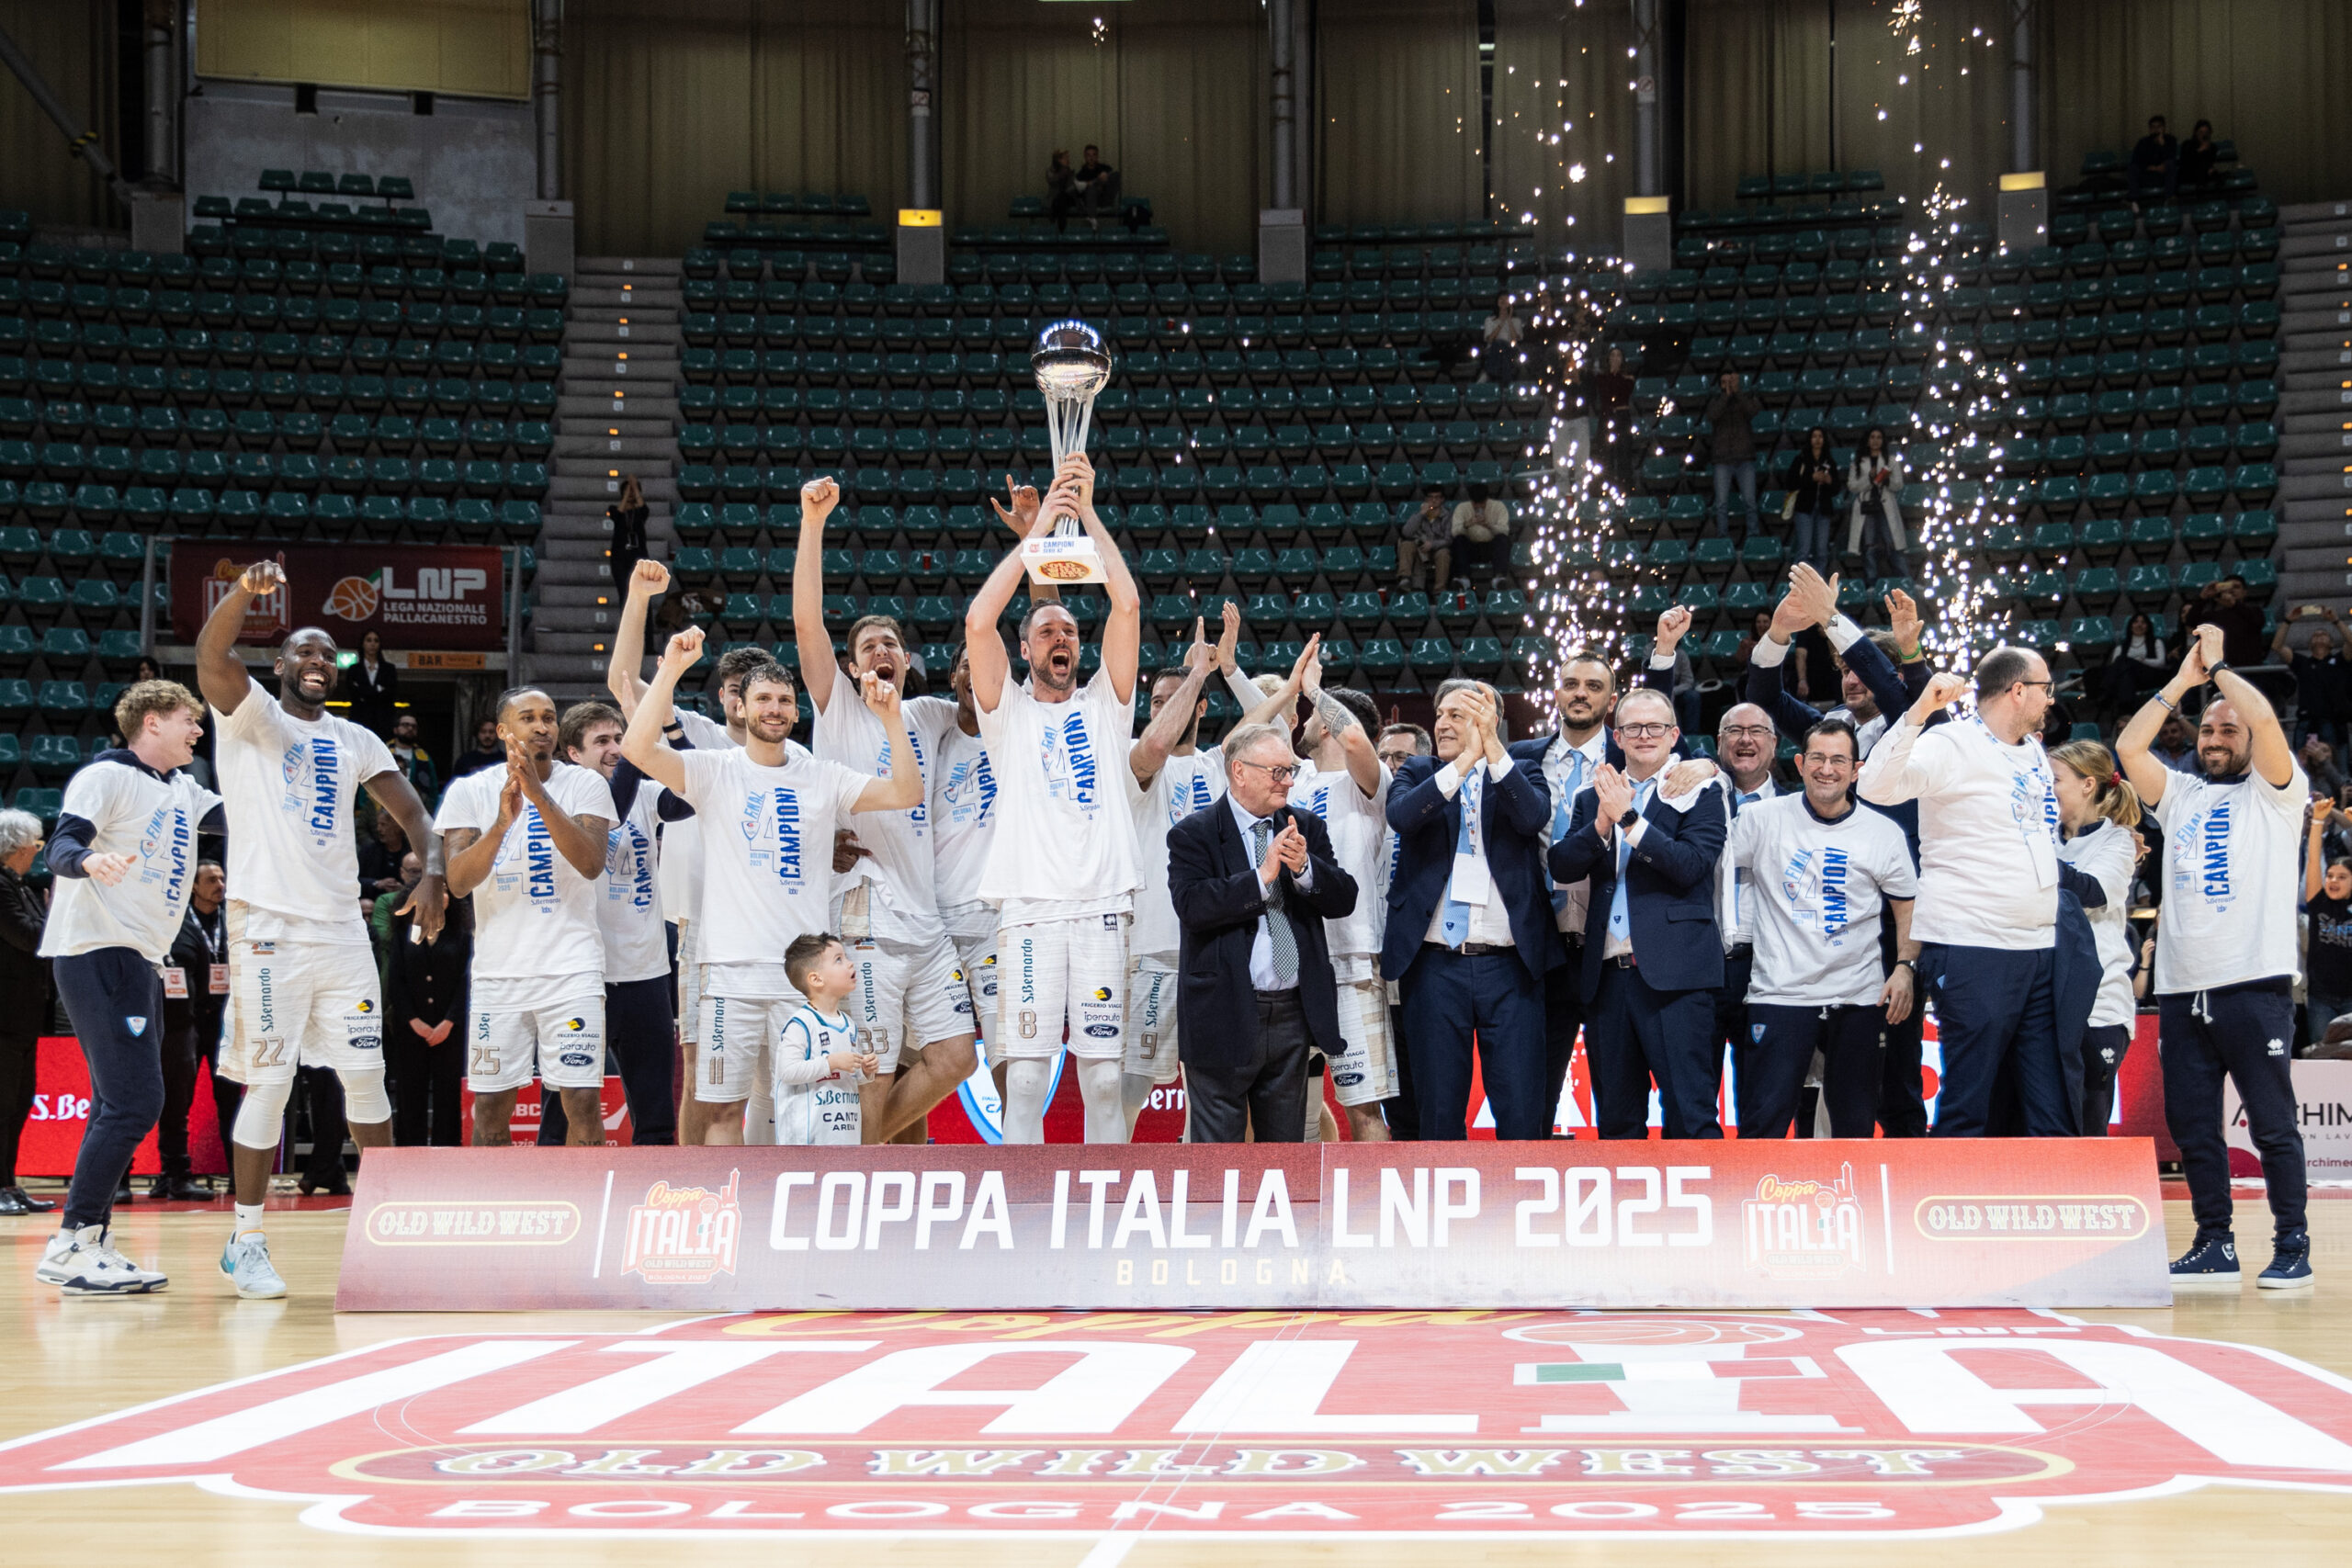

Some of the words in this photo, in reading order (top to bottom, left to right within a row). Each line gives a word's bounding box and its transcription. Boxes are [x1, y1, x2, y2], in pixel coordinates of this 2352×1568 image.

[1043, 540, 1075, 548] CAMPIONI
[382, 567, 487, 600] LNP
[383, 603, 415, 613] LEGA
[418, 604, 486, 615] NAZIONALE
[383, 614, 487, 625] PALLACANESTRO
[419, 656, 442, 665] BAR
[1063, 711, 1096, 804] CAMPIONI
[311, 738, 338, 830] CAMPIONI
[744, 791, 765, 820] FINAL
[145, 807, 168, 840] FINAL
[775, 787, 801, 879] CAMPIONI
[166, 807, 189, 901] CAMPIONI
[1784, 848, 1812, 881] FINAL
[2203, 801, 2231, 897] CAMPIONI
[1823, 847, 1849, 934] CAMPIONI
[1021, 938, 1035, 1004] S.Bernardo
[257, 967, 274, 1032] S.Bernardo
[861, 962, 878, 1022] S.Bernardo
[712, 997, 726, 1053] S.Bernard
[1018, 1008, 1037, 1039] 8
[1091, 1025, 1114, 1037] Ford
[251, 1036, 286, 1068] 22
[858, 1026, 889, 1055] 33
[1140, 1031, 1158, 1060] 9
[469, 1044, 501, 1075] 25
[563, 1055, 588, 1066] Ford
[709, 1055, 724, 1084] 11
[1337, 1075, 1359, 1085] Ford
[649, 1184, 705, 1209] Coppa
[1760, 1178, 1818, 1202] Coppa
[378, 1209, 429, 1236] OLD
[432, 1210, 498, 1236] WILD
[499, 1210, 571, 1235] WEST
[770, 1170, 1014, 1250] COPPA
[1050, 1169, 1299, 1249] ITALIA
[1332, 1168, 1481, 1247] LNP
[1515, 1166, 1713, 1247] 2025
[1927, 1204, 1982, 1231] OLD
[1985, 1204, 2057, 1231] WILD
[2062, 1205, 2136, 1231] WEST
[627, 1210, 737, 1268] ITALIA
[1747, 1204, 1860, 1263] ITALIA
[645, 1259, 663, 1269] OLD
[664, 1259, 686, 1269] WILD
[689, 1259, 714, 1269] WEST
[1117, 1258, 1348, 1285] BOLOGNA
[40, 1338, 2352, 1472] ITALIA
[433, 1448, 826, 1475] OLD
[867, 1449, 1368, 1475] WILD
[1394, 1449, 1968, 1475] WEST
[426, 1500, 1362, 1519] BOLOGNA
[1435, 1500, 1896, 1519] 2025
